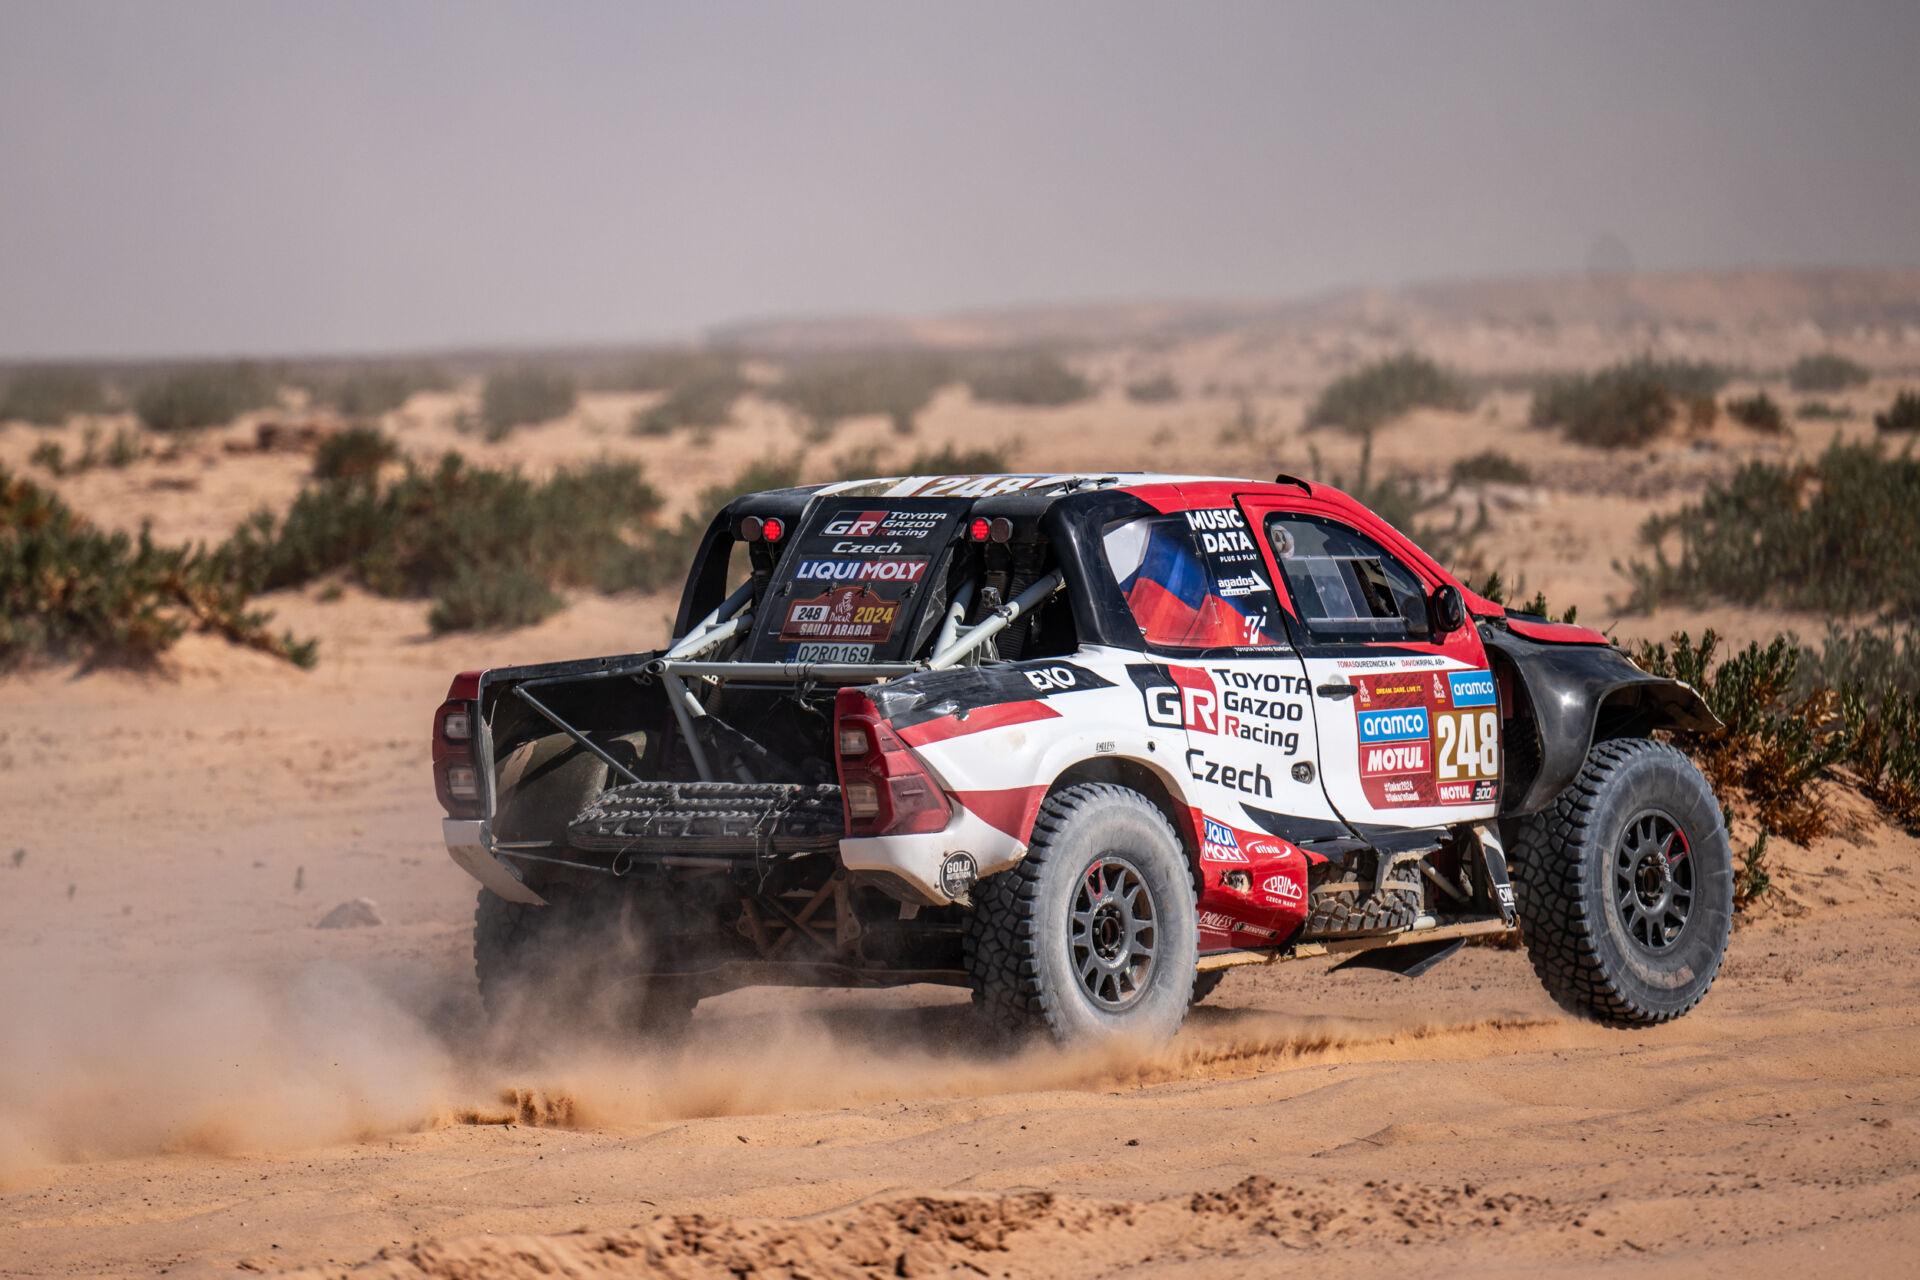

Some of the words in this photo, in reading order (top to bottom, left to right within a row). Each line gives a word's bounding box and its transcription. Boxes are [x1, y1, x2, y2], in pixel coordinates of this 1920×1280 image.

[881, 520, 937, 528] GAZOO
[890, 511, 948, 520] TOYOTA
[1185, 509, 1244, 531] MUSIC
[824, 520, 878, 535] GR
[875, 528, 929, 539] Racing
[832, 541, 903, 554] Czech
[1202, 531, 1255, 553] DATA
[1220, 555, 1236, 563] PLUG
[796, 562, 861, 580] LIQUI
[858, 562, 926, 580] MOLY
[1218, 575, 1255, 590] agados
[797, 606, 823, 621] 248
[854, 606, 894, 624] 2024
[800, 623, 833, 636] SAUDI
[832, 624, 873, 636] ARABIA
[1023, 666, 1077, 691] EXO
[1211, 668, 1312, 696] TOYOTA
[1453, 681, 1494, 697] aramco
[1145, 686, 1217, 732] GR
[1223, 691, 1303, 722] GAZOO
[1364, 714, 1424, 736] aramco
[1224, 714, 1299, 756] Racing
[1437, 711, 1498, 779] 248
[1367, 746, 1424, 772] MOTUL
[1185, 747, 1272, 799] Czech
[1440, 785, 1471, 801] MOTUL
[1474, 785, 1498, 801] 300V
[1204, 842, 1242, 861] MOLY
[946, 860, 970, 874] GOLD
[1270, 875, 1297, 897] PRIM
[1265, 895, 1281, 905] CZECH
[1282, 899, 1297, 908] MADE
[1200, 911, 1236, 928] ENDLESS
